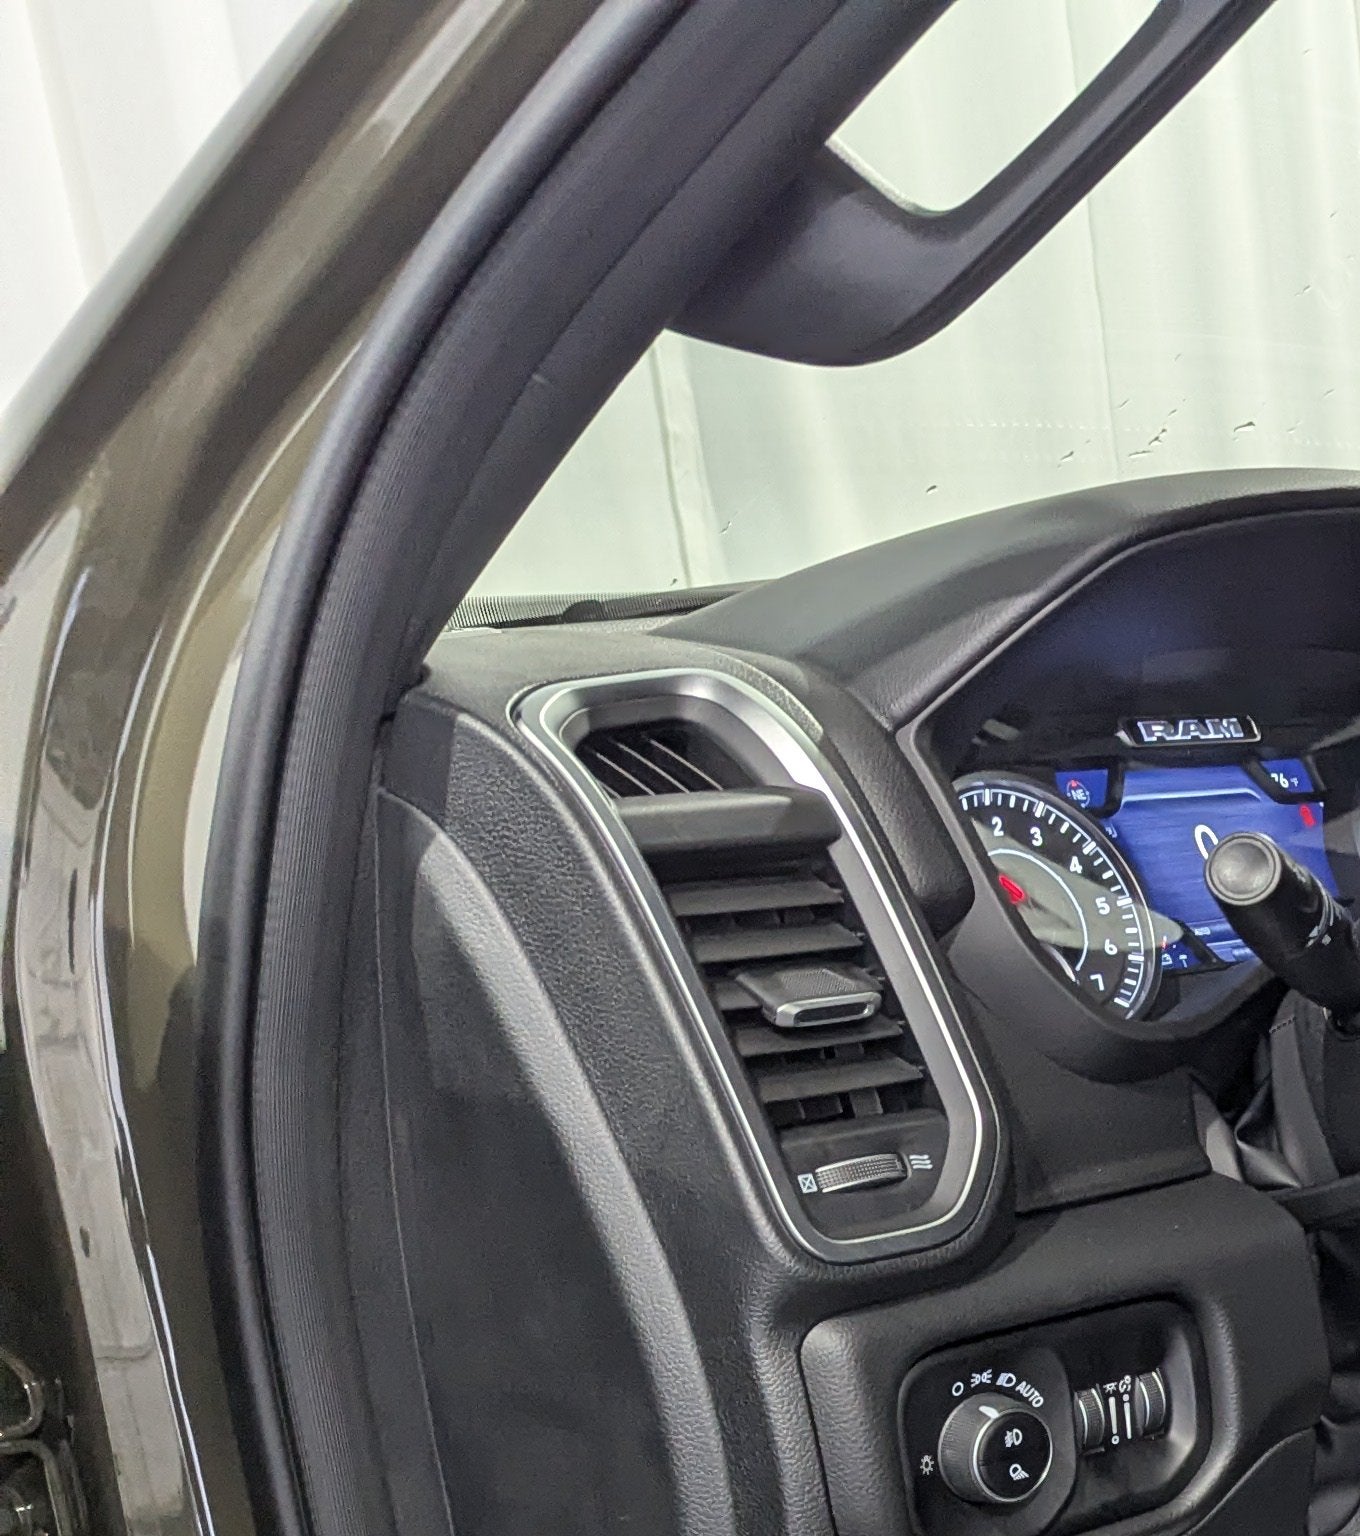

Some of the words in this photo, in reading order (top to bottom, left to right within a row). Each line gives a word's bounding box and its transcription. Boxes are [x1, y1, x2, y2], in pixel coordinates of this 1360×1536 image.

[1136, 717, 1245, 742] RAM
[1071, 788, 1087, 800] NE
[991, 816, 1004, 837] 2
[1030, 826, 1043, 847] 3
[1069, 855, 1083, 874] 4
[1095, 897, 1110, 915] 5
[1104, 938, 1118, 956] 6
[1090, 973, 1104, 991] 7
[1015, 1380, 1044, 1408] AUTO
